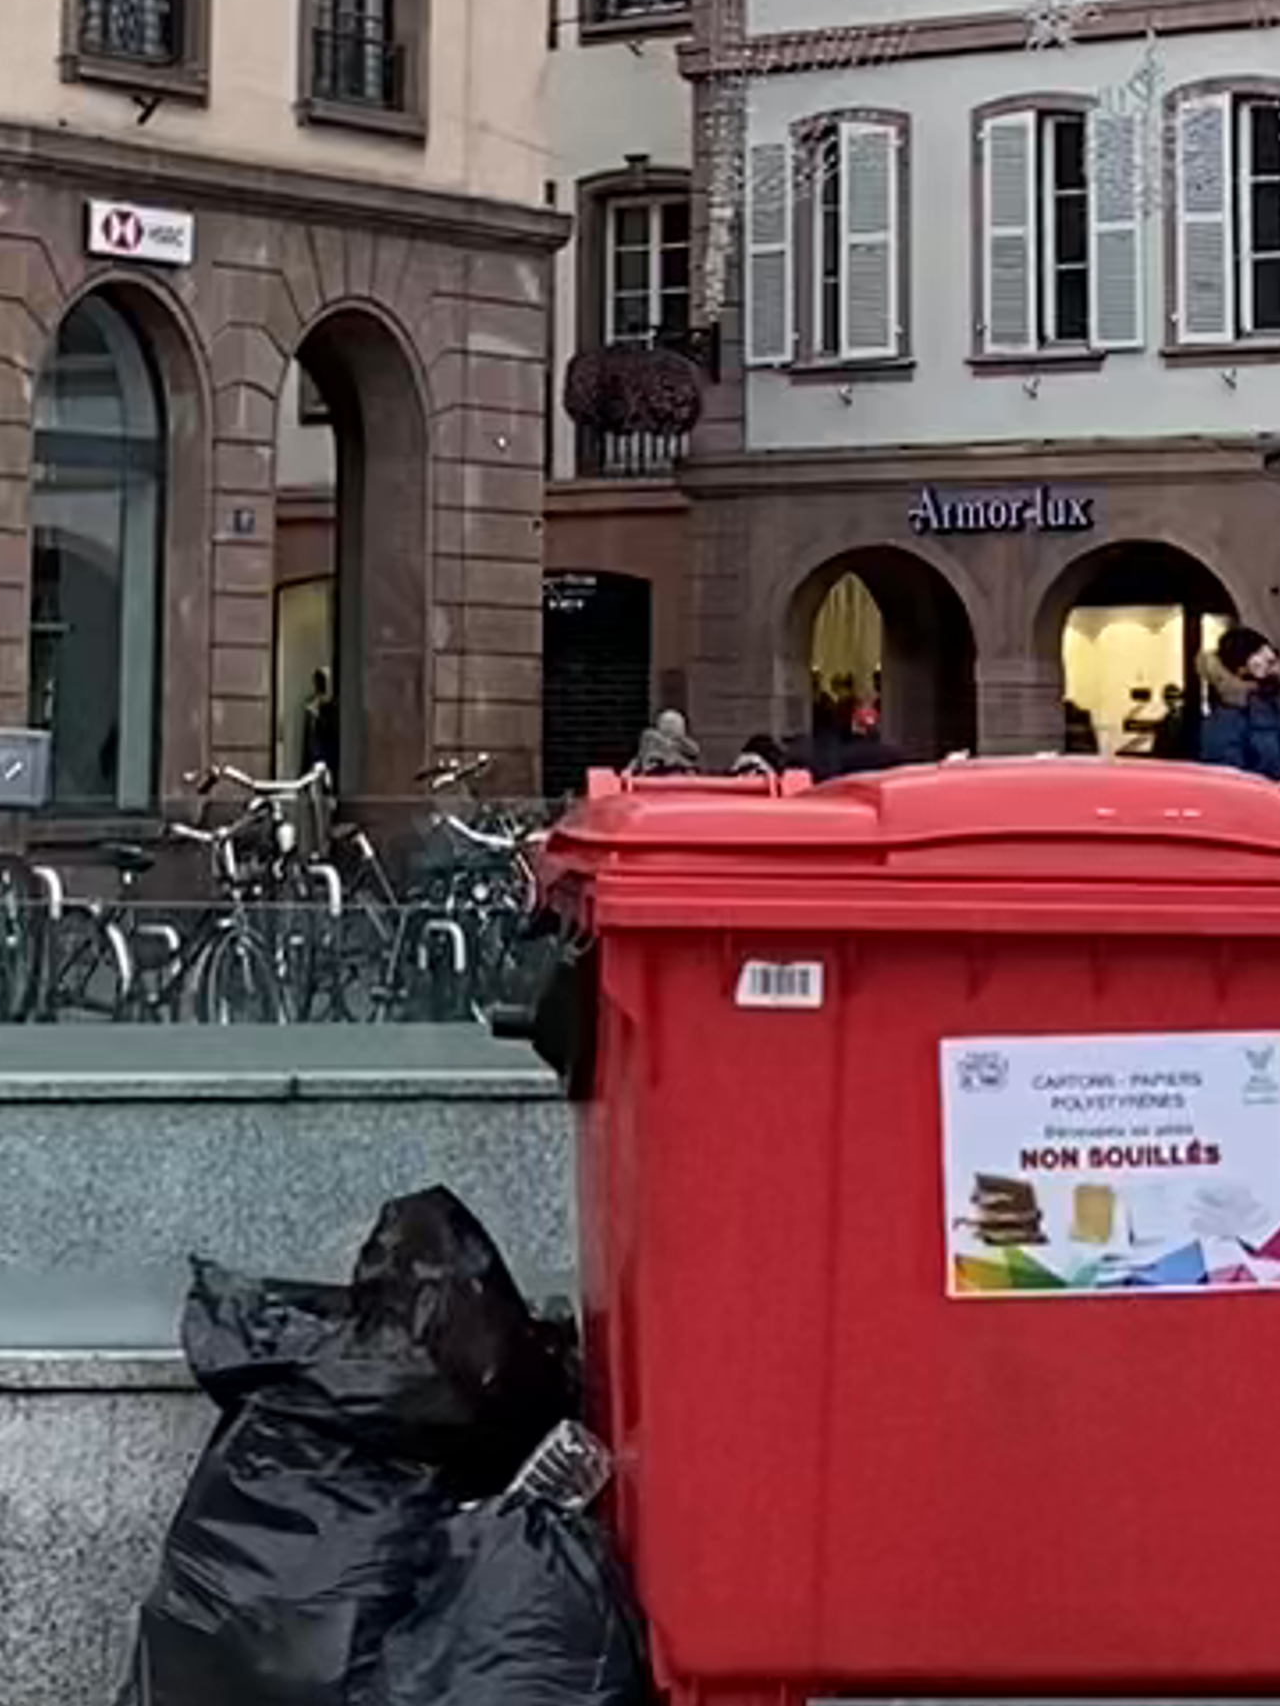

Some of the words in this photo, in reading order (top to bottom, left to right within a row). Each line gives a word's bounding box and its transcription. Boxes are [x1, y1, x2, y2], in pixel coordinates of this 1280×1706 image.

[908, 485, 1091, 532] Armor-lux
[1020, 1148, 1079, 1170] NON
[1089, 1140, 1221, 1168] SOUILLÉS
